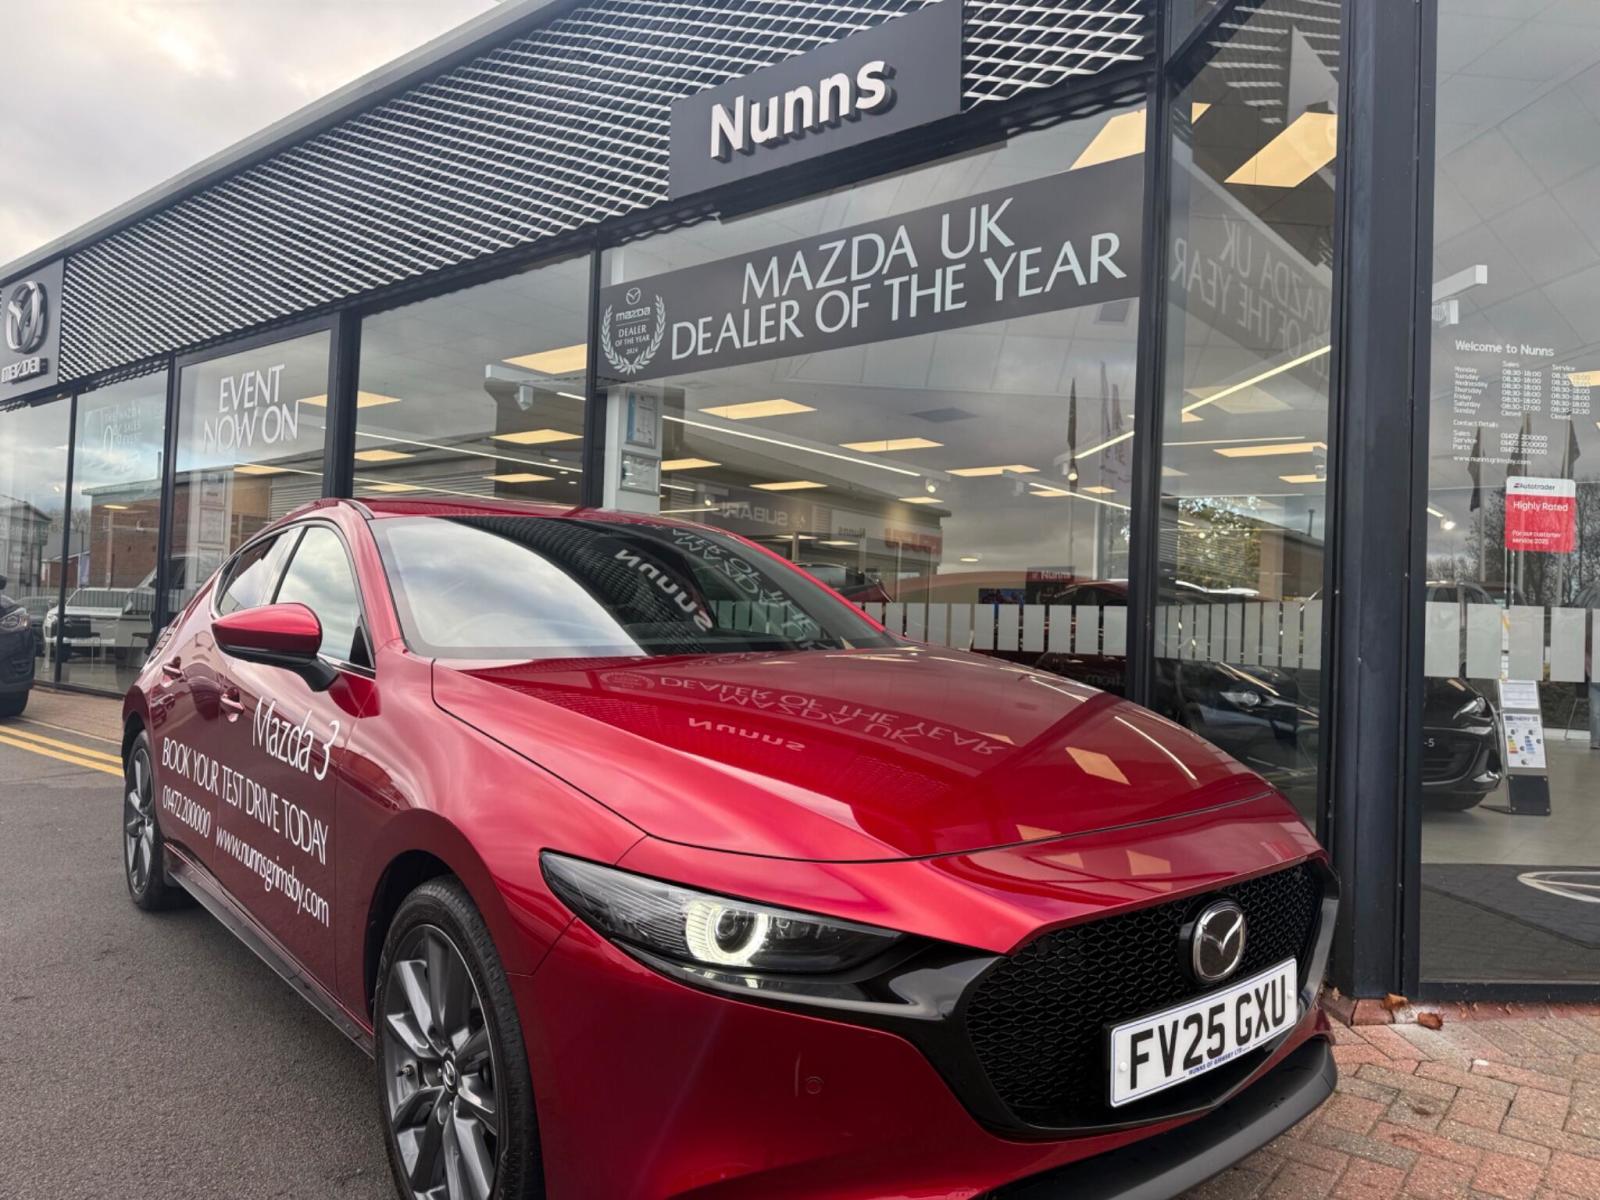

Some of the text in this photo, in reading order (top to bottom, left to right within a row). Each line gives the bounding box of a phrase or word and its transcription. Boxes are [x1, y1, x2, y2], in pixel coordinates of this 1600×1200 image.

[710, 59, 887, 160] Nunns
[742, 198, 1014, 304] MAZDA UK
[672, 232, 1126, 360] DEALER OF THE YEAR
[618, 325, 647, 338] DEALER
[624, 337, 634, 345] THE
[635, 335, 650, 344] YEAR
[1455, 340, 1555, 356] Welcome to Nunns
[2, 357, 40, 382] mazda
[219, 364, 285, 413] EVENT
[203, 401, 299, 452] NOW ON
[1513, 501, 1568, 512] Highly Rated
[252, 696, 340, 781] Mazda 3
[162, 737, 328, 866] BOOK YOUR TEST DRIVE TODAY
[216, 825, 330, 928] www.nunnsgrimsby.com
[1130, 974, 1286, 1090] FV25 GXU
